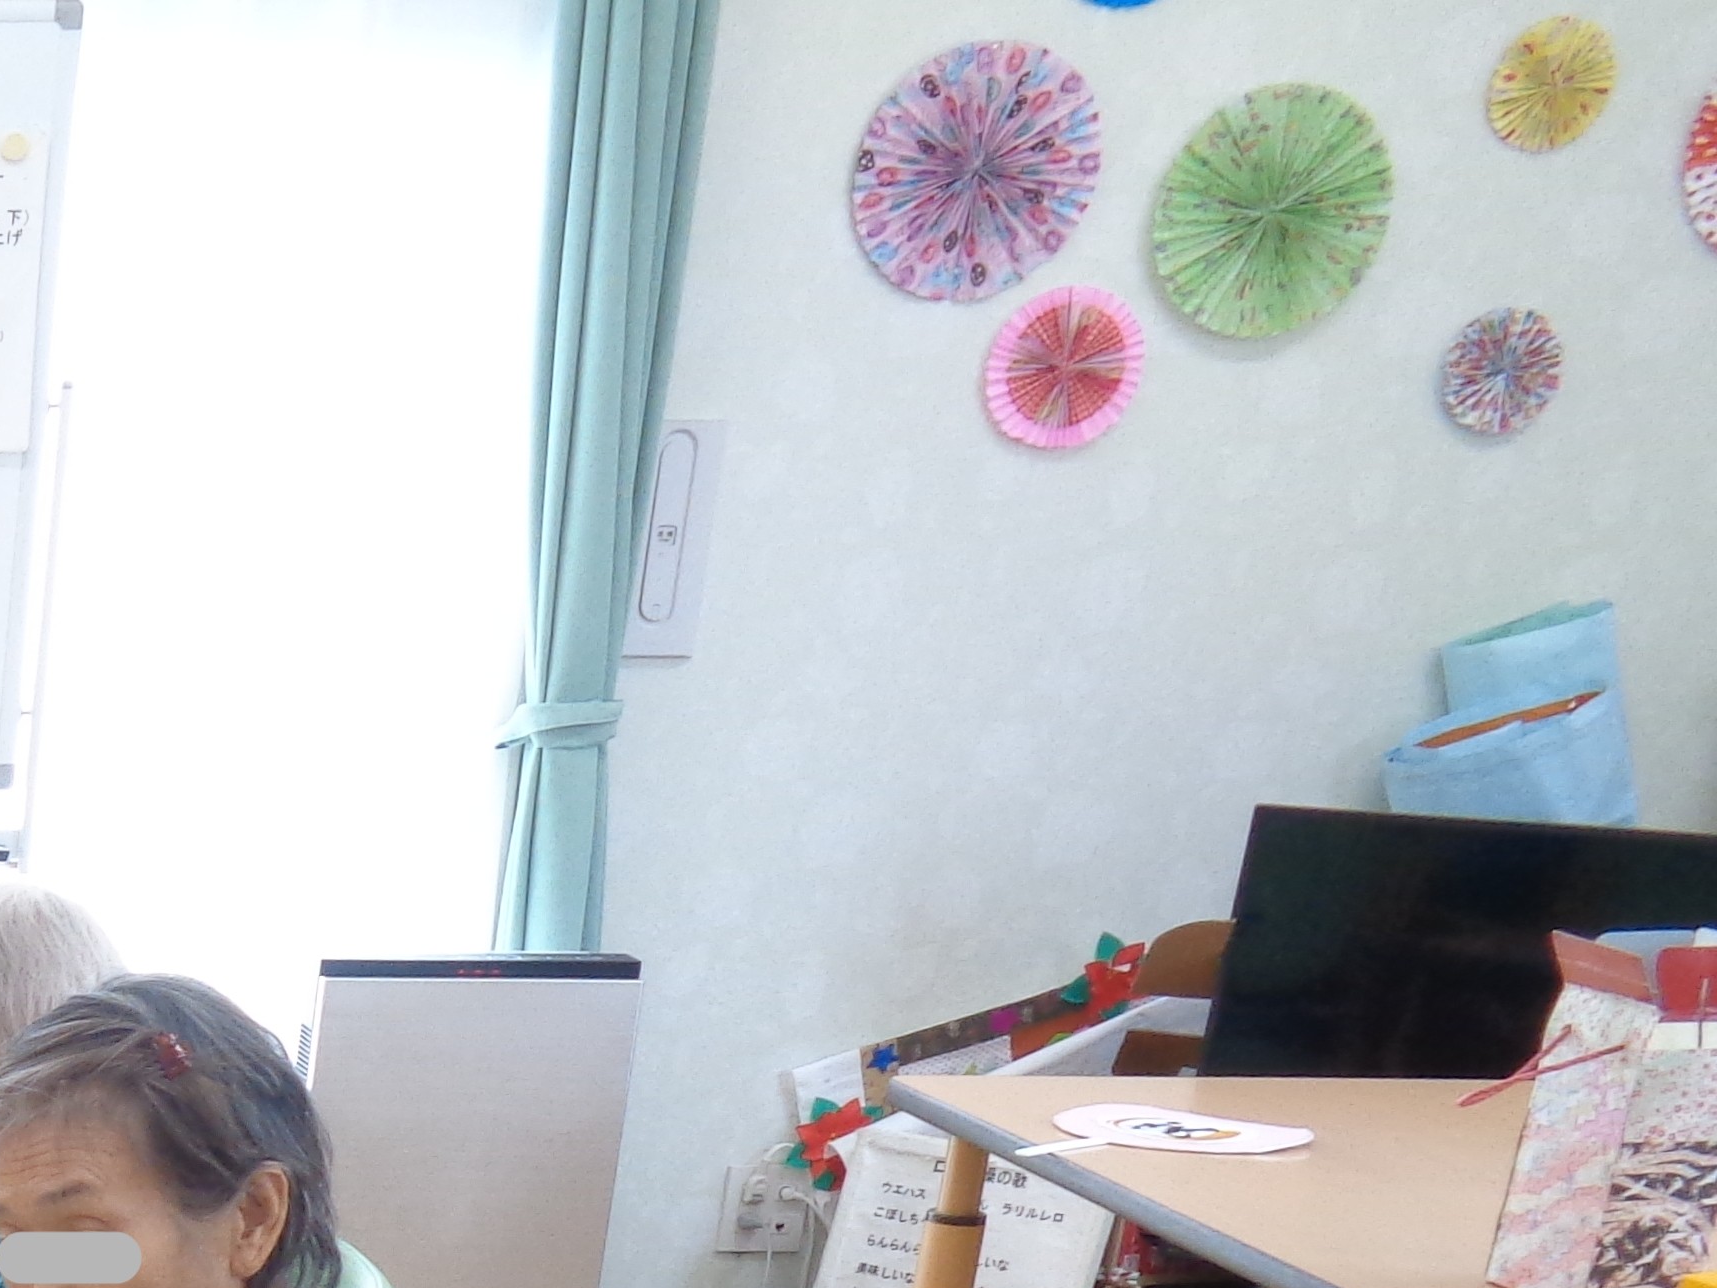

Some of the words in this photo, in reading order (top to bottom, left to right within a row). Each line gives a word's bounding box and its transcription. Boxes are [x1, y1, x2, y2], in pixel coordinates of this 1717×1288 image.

[881, 1182, 926, 1199] ウエハス
[1002, 1202, 1065, 1223] ラリルレロ
